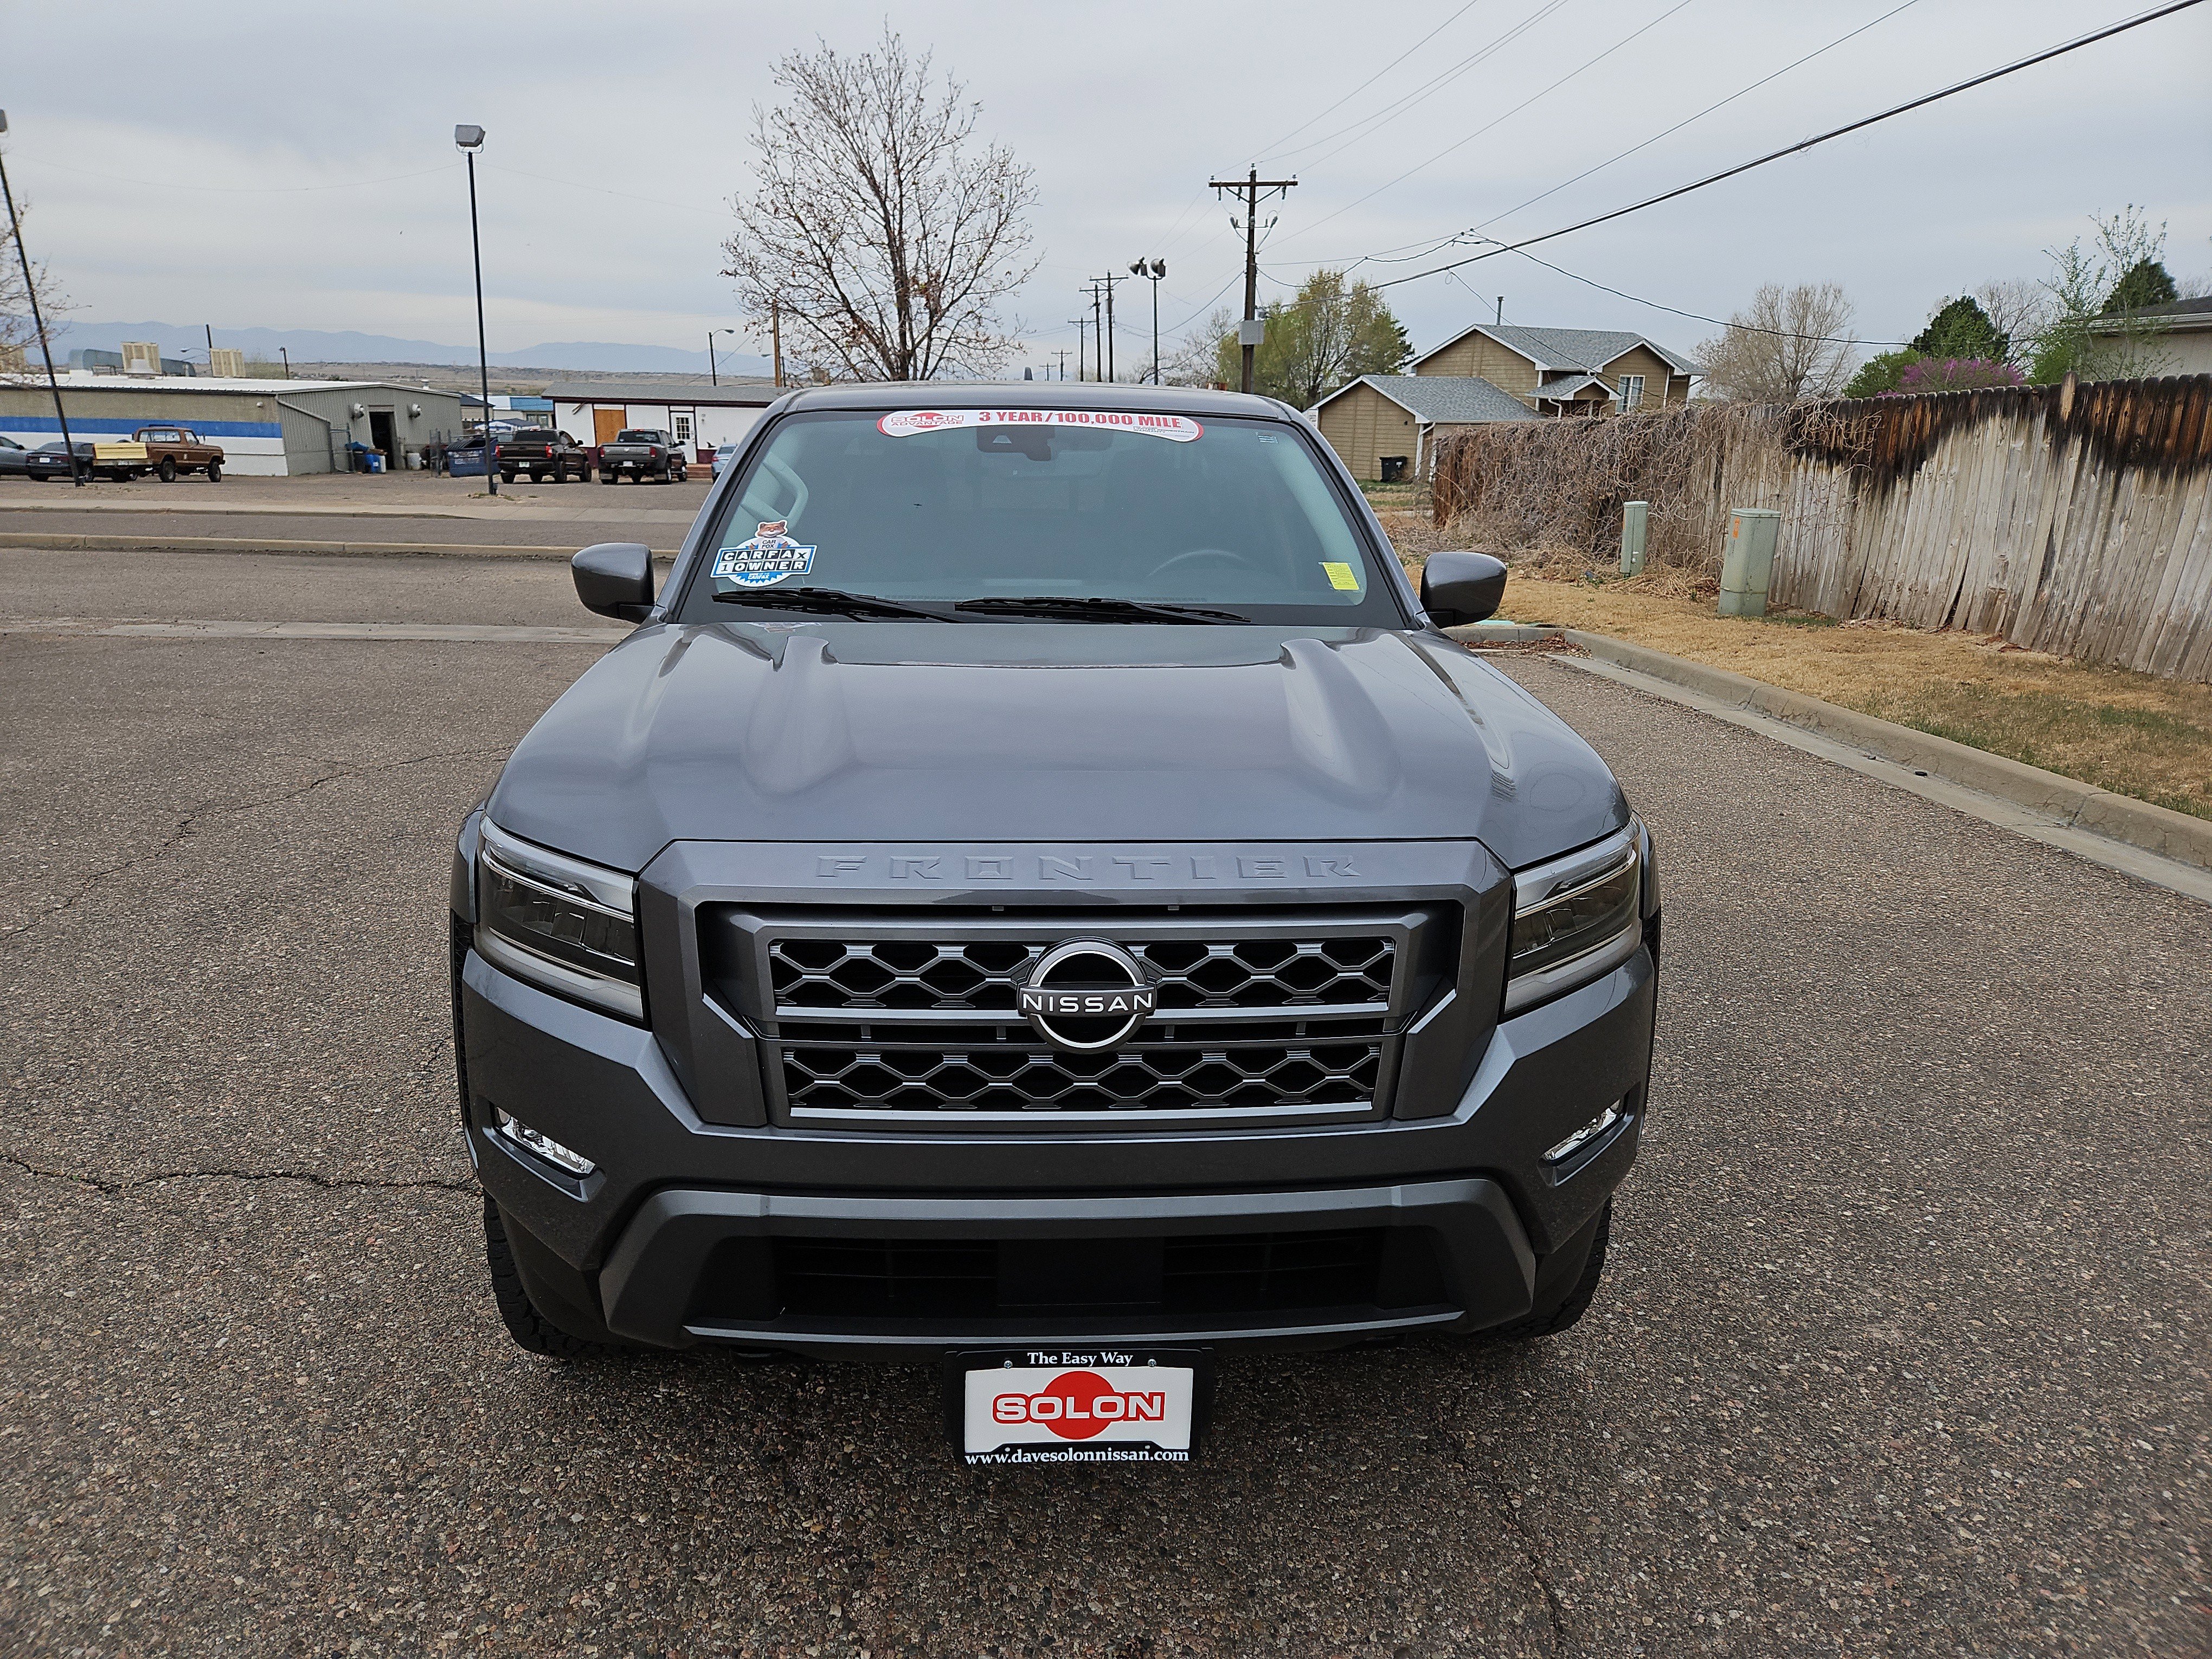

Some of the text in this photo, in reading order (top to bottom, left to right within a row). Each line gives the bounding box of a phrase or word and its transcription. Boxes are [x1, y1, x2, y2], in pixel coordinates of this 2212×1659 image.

[979, 411, 1182, 428] 3 YEAR/100,000 MILE
[724, 549, 808, 561] CARFAX
[734, 561, 805, 571] OWNER
[815, 856, 1361, 880] FRONTIER
[1023, 993, 1152, 1012] NISSAN
[1027, 1352, 1134, 1367] The Easy Way
[994, 1393, 1164, 1423] SOLON
[965, 1448, 1189, 1464] www.davesolonnissan.com
